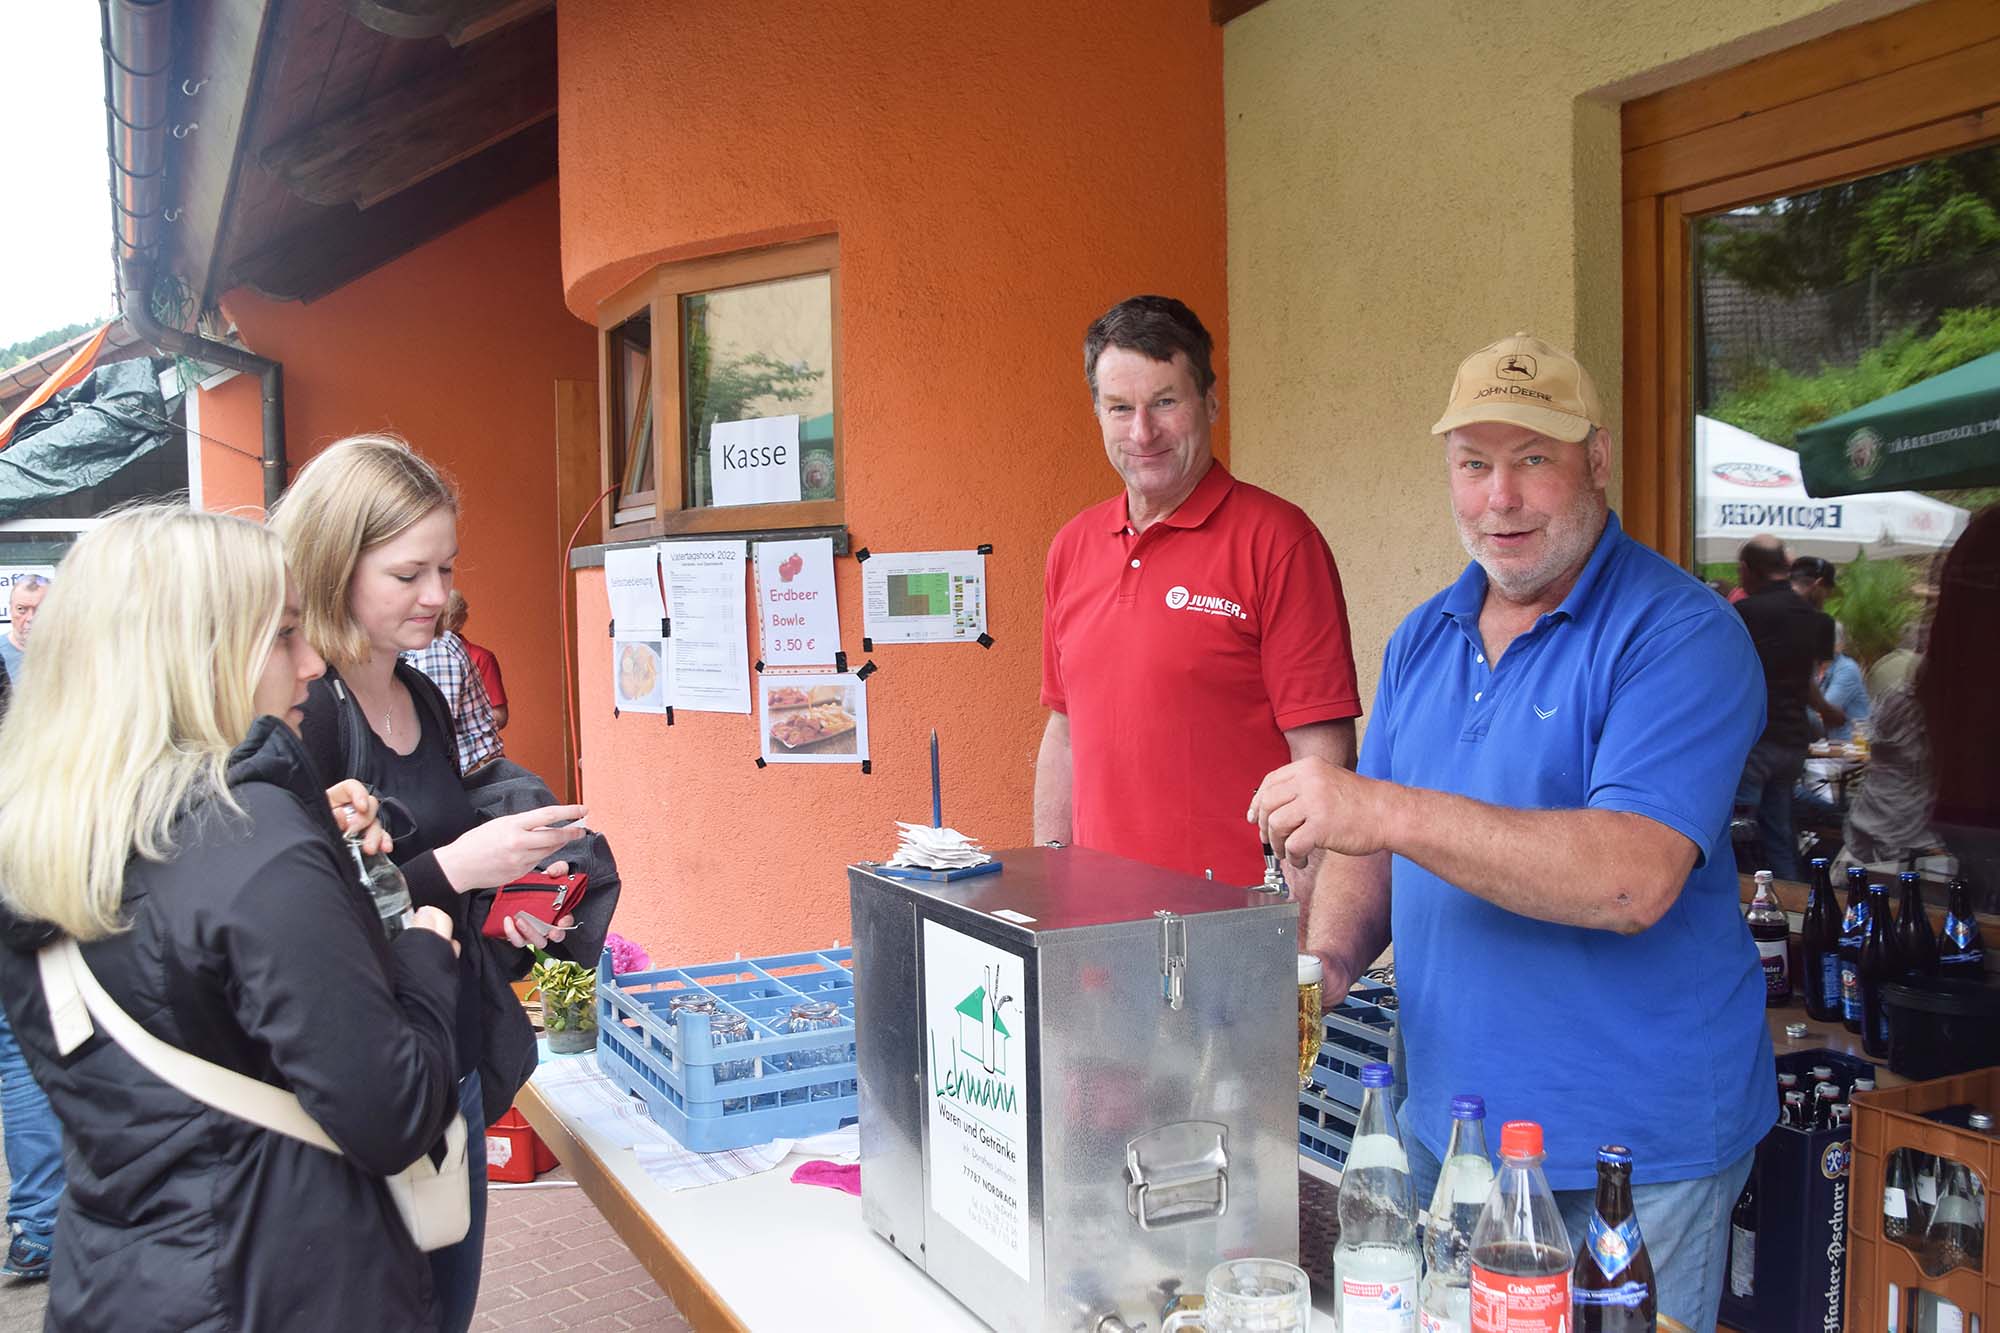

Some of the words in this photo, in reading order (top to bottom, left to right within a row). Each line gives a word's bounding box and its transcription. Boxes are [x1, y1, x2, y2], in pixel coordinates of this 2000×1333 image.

[1473, 386, 1507, 400] JOHN
[1510, 385, 1553, 401] DEERE
[723, 443, 787, 470] Kasse
[718, 550, 736, 561] 2022
[769, 588, 818, 602] Erdbeer
[772, 613, 806, 627] Bowle
[774, 638, 802, 652] 3.50
[806, 638, 816, 651] €
[931, 1028, 1018, 1115] Lehmann
[938, 1101, 962, 1129] Waren
[964, 1121, 978, 1139] und
[979, 1127, 1017, 1163] Getränke
[963, 1164, 981, 1185] 77787
[982, 1178, 1017, 1210] NORDRACH
[1823, 1182, 1845, 1333] Hacker-Pschorr
